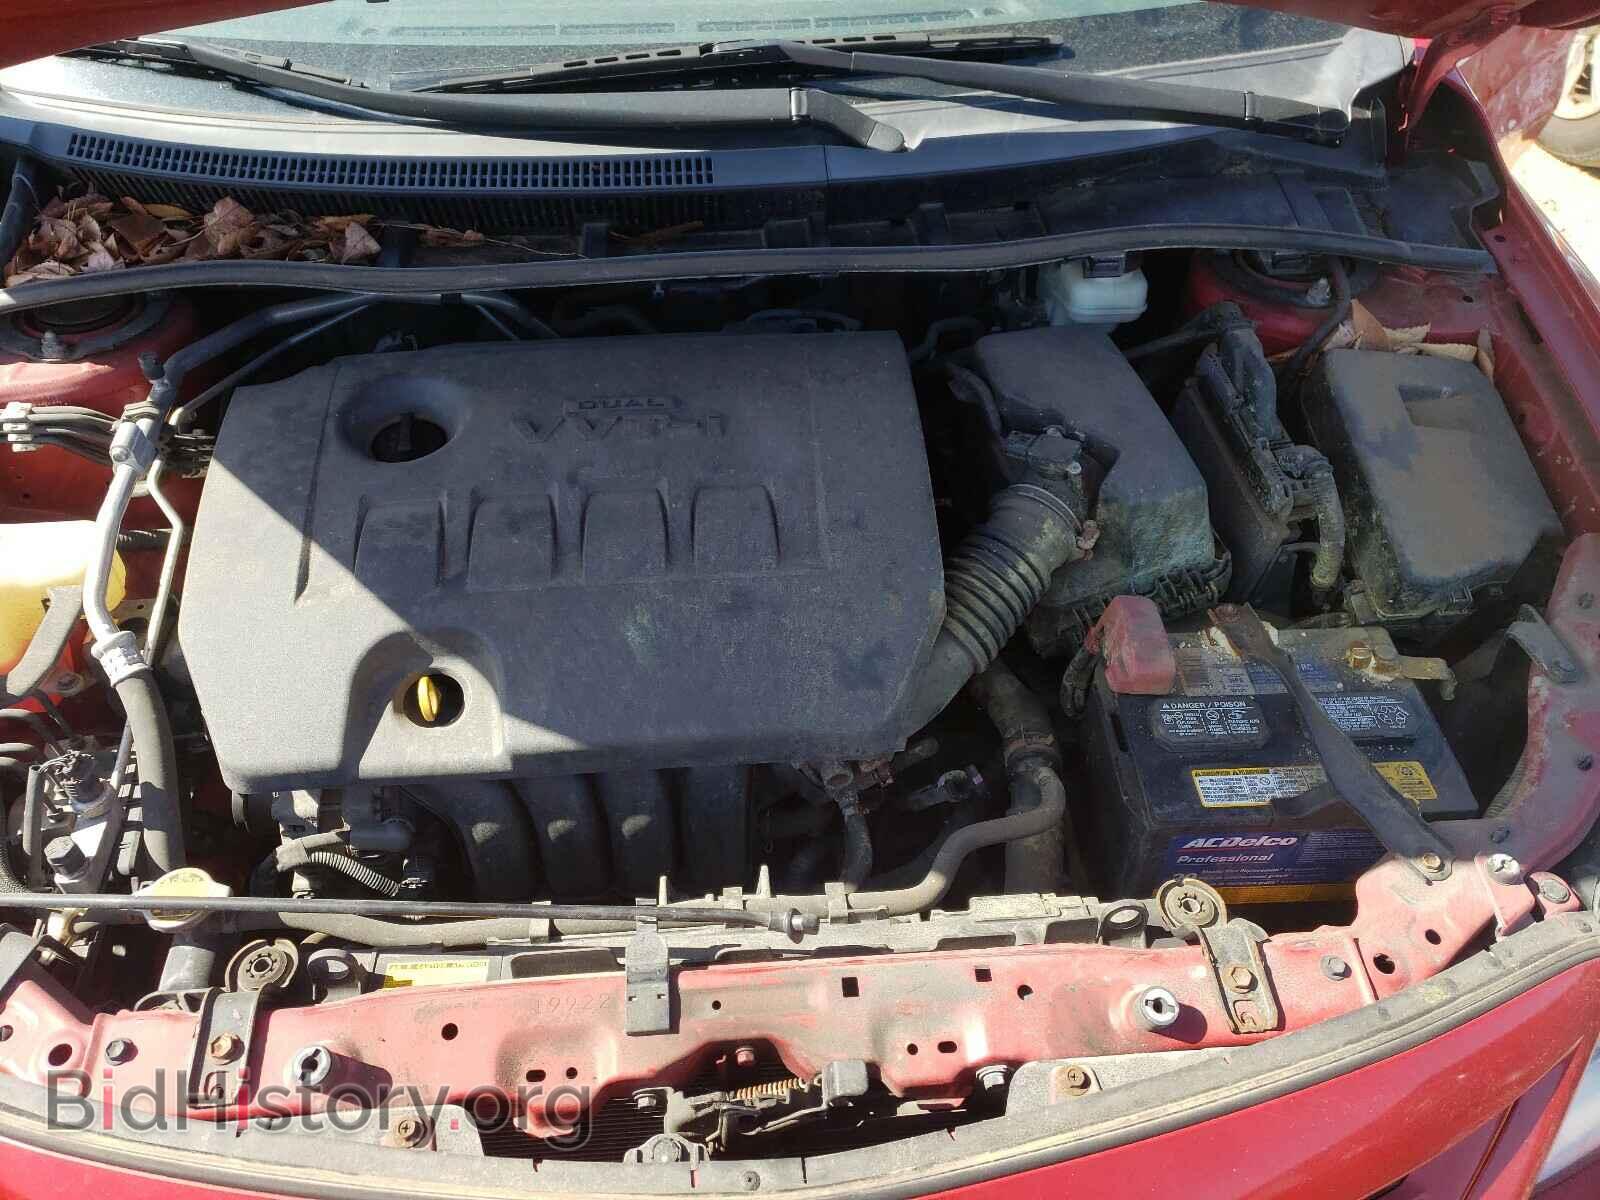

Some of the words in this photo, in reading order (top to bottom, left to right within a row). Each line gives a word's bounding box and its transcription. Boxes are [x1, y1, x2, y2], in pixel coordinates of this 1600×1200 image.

[577, 397, 666, 410] DUAL
[1182, 835, 1298, 848] ACDelco
[1177, 853, 1274, 864] Professional
